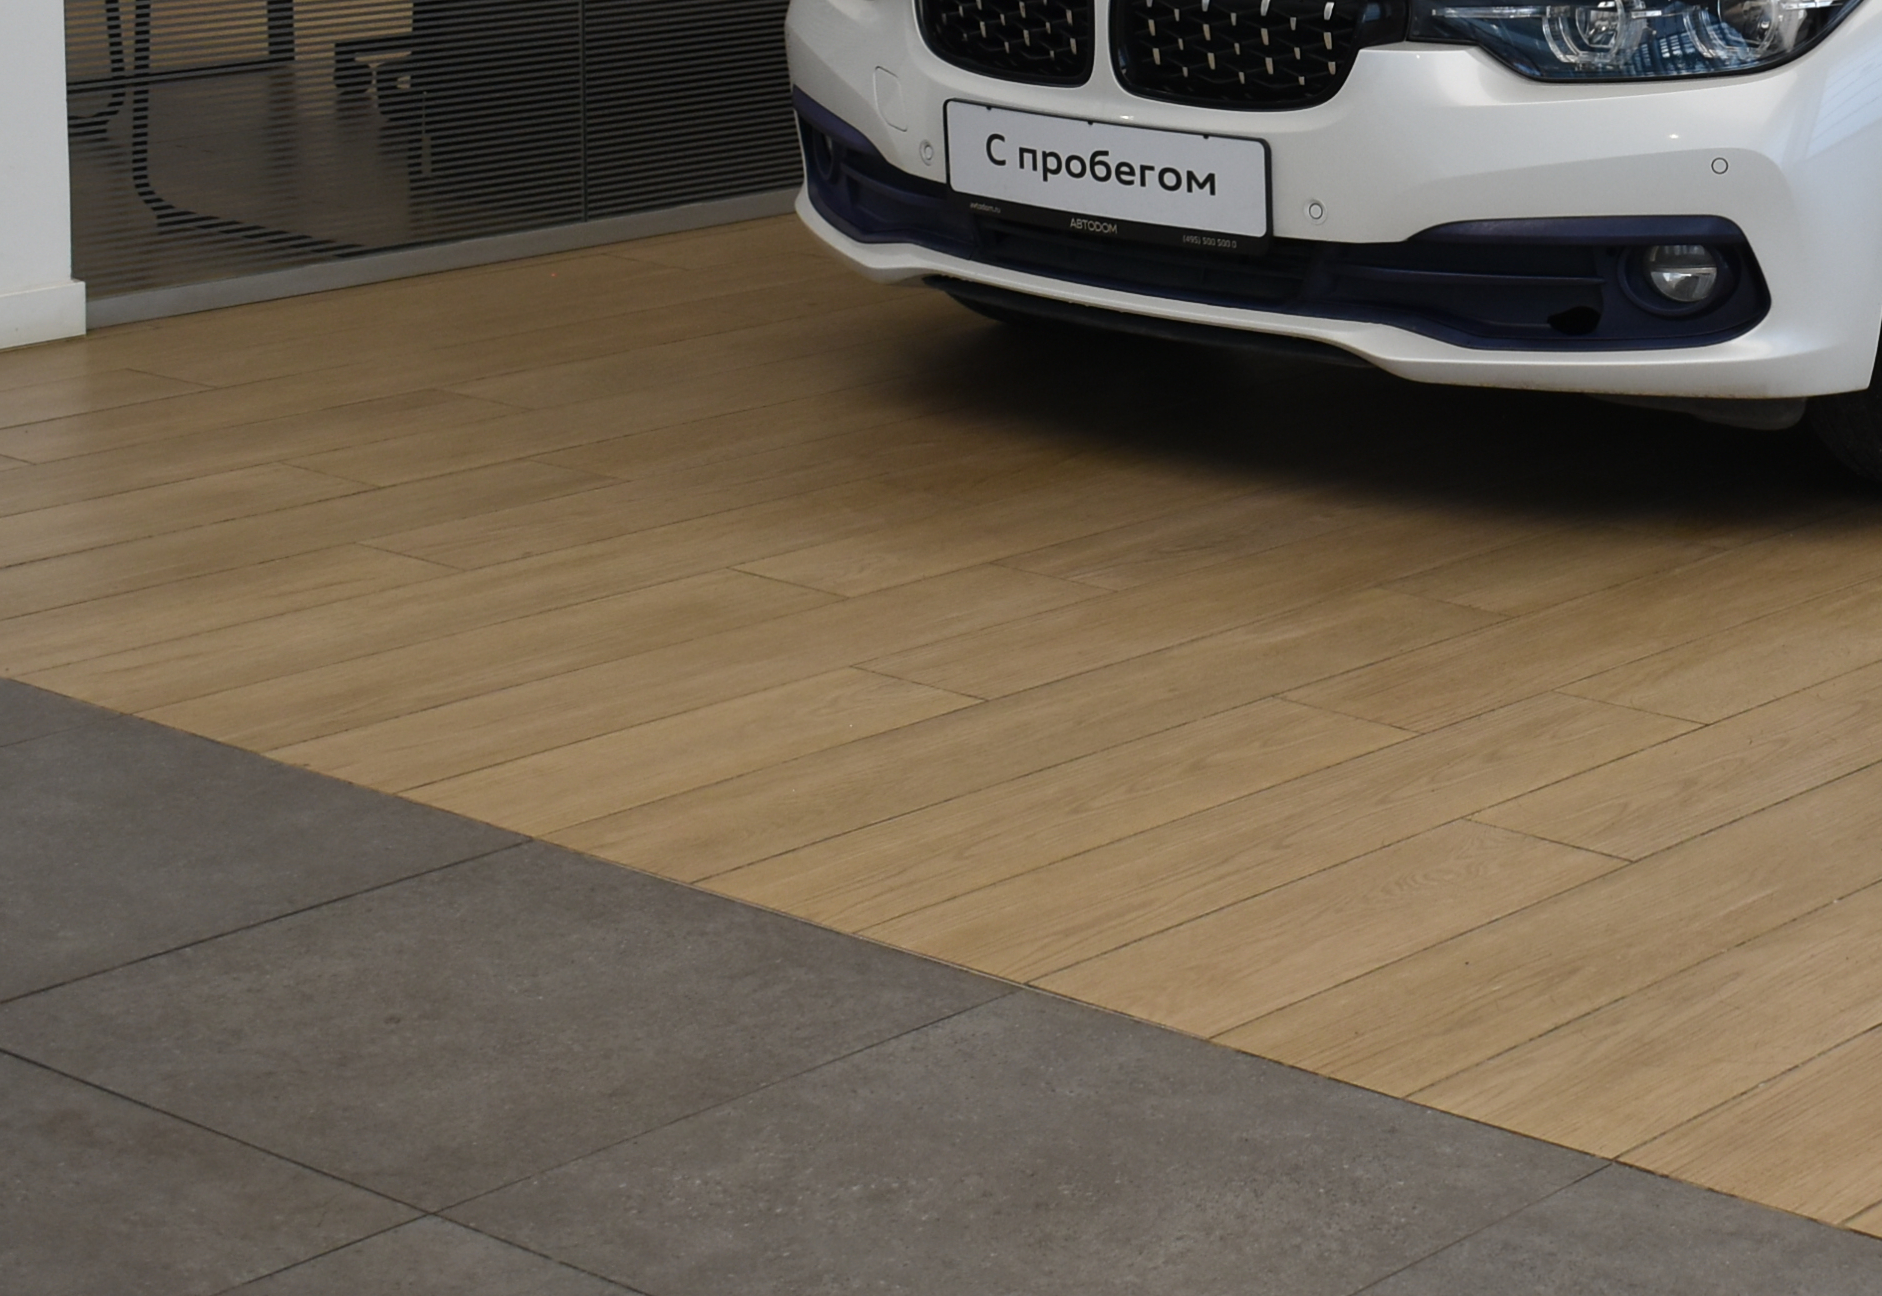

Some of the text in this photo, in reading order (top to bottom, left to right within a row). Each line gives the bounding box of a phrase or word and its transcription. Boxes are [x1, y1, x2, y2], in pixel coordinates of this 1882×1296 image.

[985, 133, 1217, 196] С пробегом
[969, 202, 1001, 214] avtodom.ru
